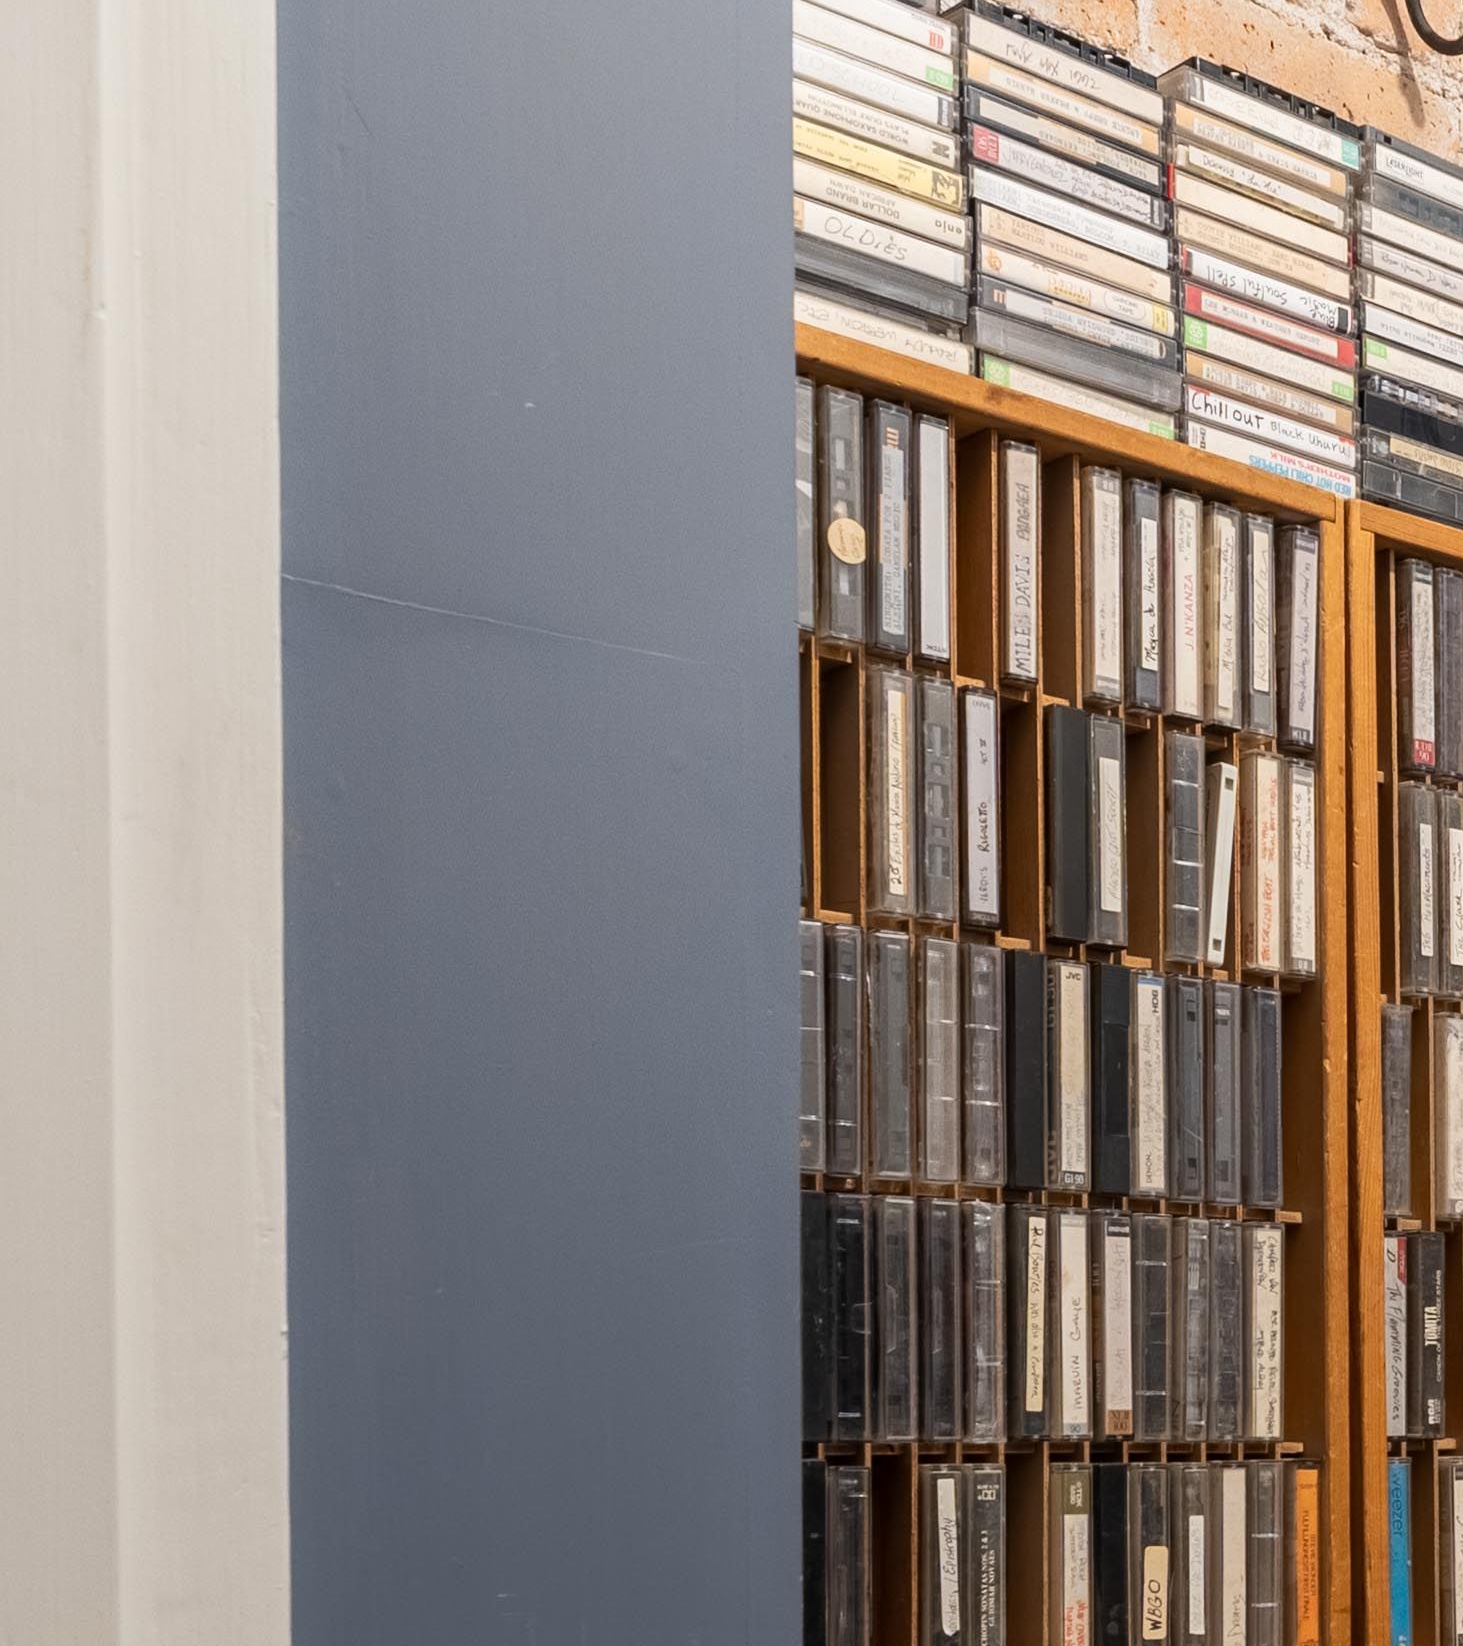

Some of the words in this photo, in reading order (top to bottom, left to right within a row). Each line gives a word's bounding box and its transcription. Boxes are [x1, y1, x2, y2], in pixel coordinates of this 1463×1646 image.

[823, 107, 877, 138] SAXOPHONE
[879, 129, 909, 145] WORLD
[826, 186, 857, 206] BRAND
[861, 201, 900, 220] DOLLAR
[935, 219, 962, 236] enja
[1242, 276, 1288, 308] Soulful
[1270, 419, 1301, 442] Black
[1248, 454, 1289, 479] PEPPERS
[1269, 451, 1297, 467] MILK
[1288, 467, 1314, 488] CHILI
[1315, 474, 1333, 493] HOT
[1333, 481, 1352, 498] RED
[1013, 554, 1032, 609] DAVIS
[1012, 614, 1033, 675] MILES
[1065, 970, 1083, 982] JVC
[1143, 1153, 1153, 1184] DENON
[1423, 1306, 1438, 1347] TOMITA
[1427, 1399, 1436, 1425] RCA
[1392, 1475, 1403, 1536] weezer
[942, 1516, 958, 1577] Epistrophy
[979, 1553, 989, 1571] NOS.
[987, 1549, 997, 1584] NOVAES
[1310, 1562, 1318, 1597] WONDER
[979, 1572, 989, 1612] SONATAS
[987, 1584, 997, 1628] GUIOMAR
[1148, 1578, 1163, 1632] WBGO
[979, 1614, 989, 1646] CHOPIN
